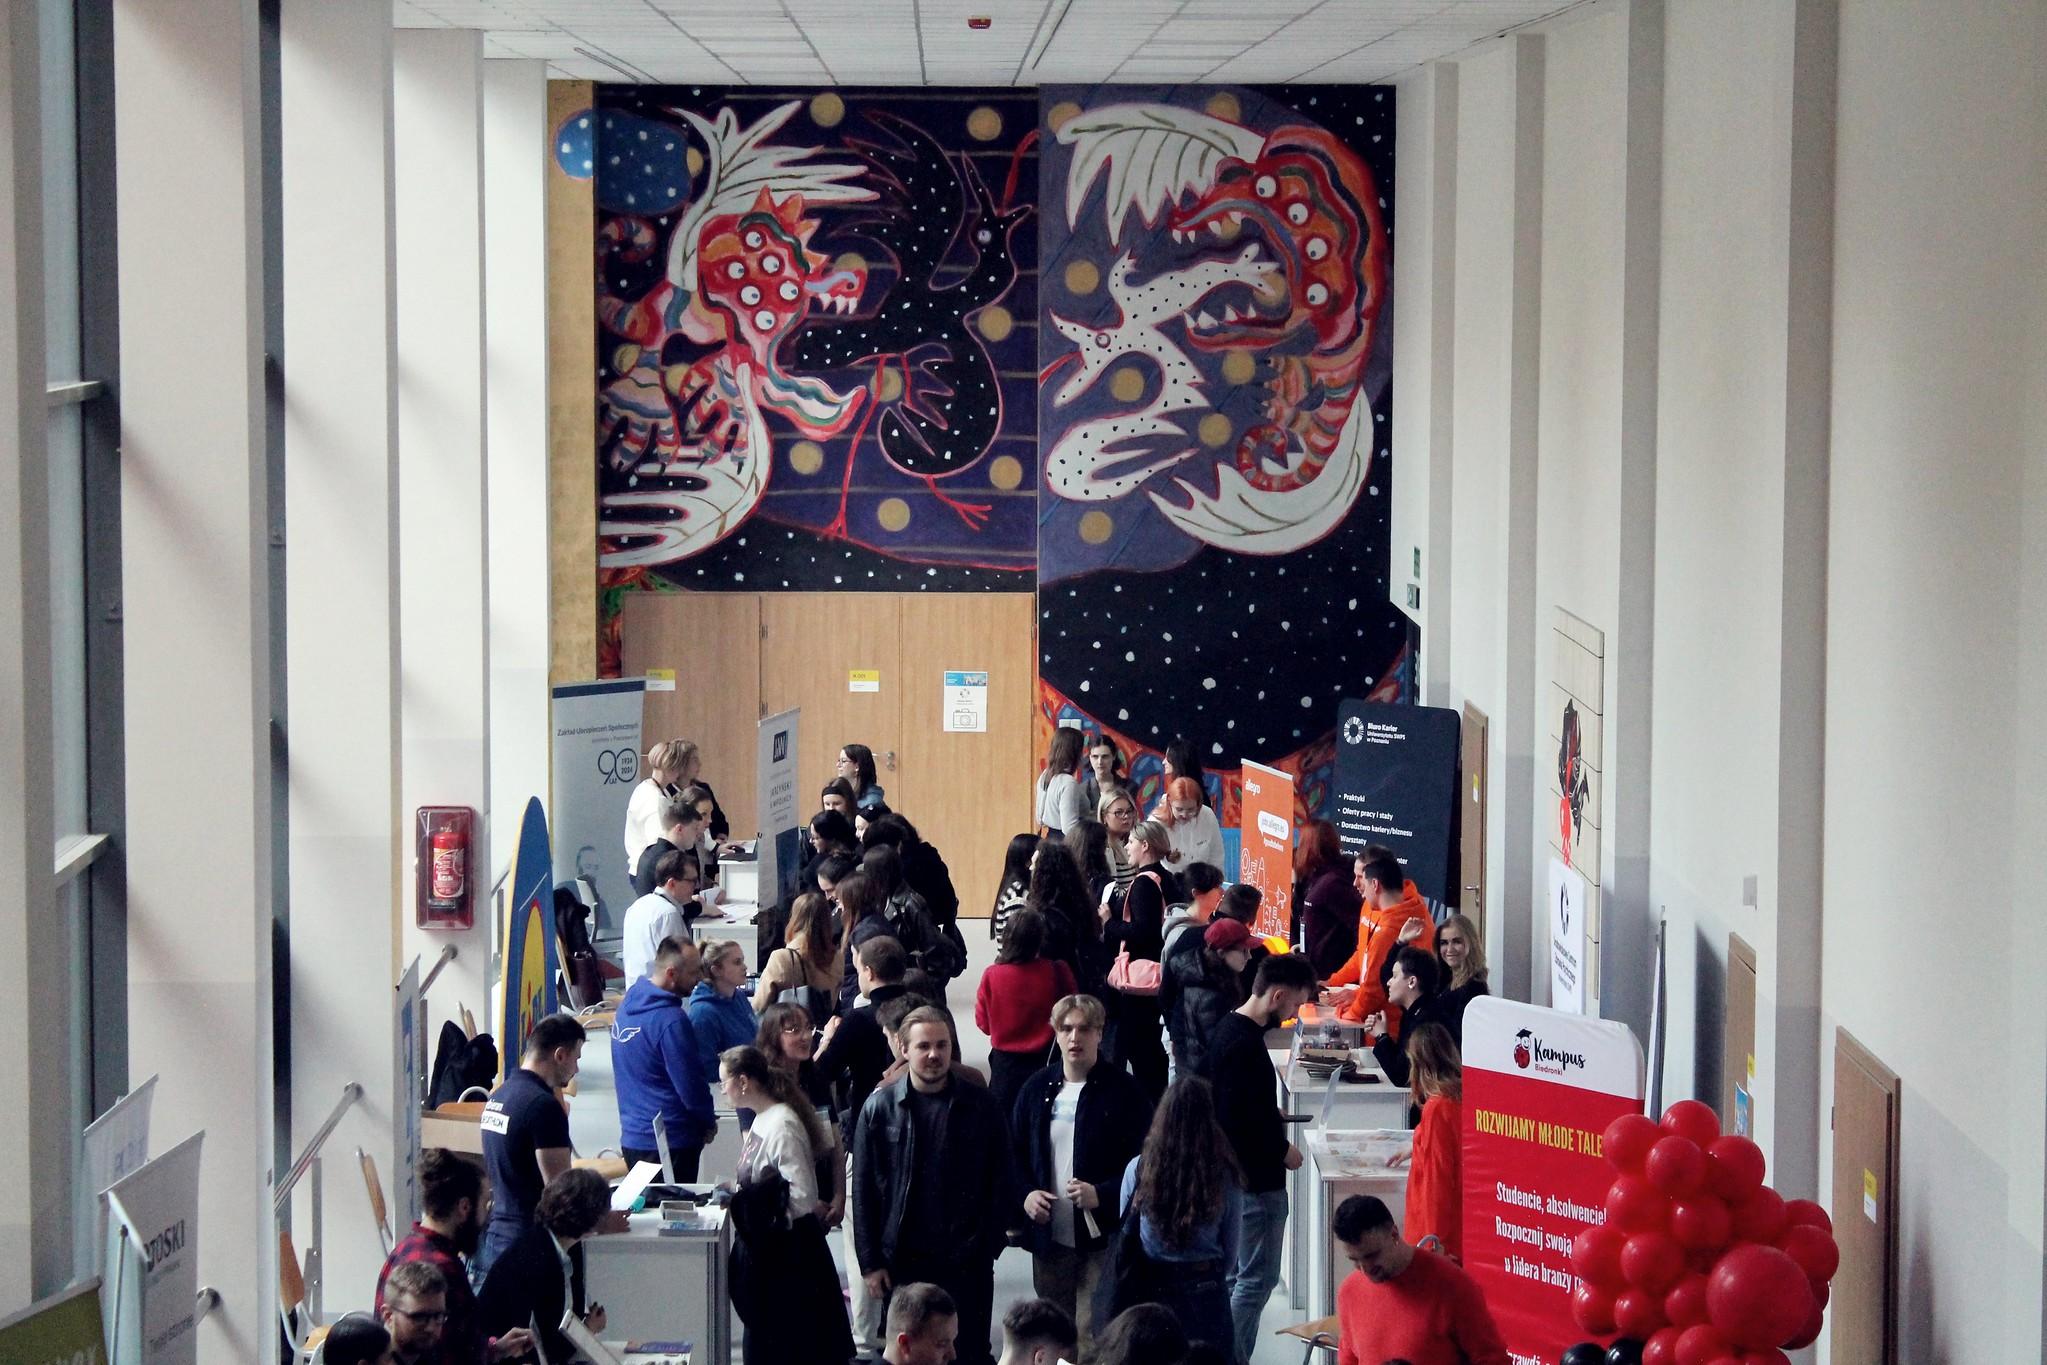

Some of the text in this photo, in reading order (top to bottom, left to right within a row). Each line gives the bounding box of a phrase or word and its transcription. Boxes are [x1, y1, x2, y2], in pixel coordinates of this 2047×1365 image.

[1367, 722, 1398, 732] Biuro Karier
[1343, 793, 1366, 803] Praktyki
[1342, 807, 1360, 817] Oferty
[1360, 810, 1376, 819] pracy
[1380, 812, 1393, 821] staży
[1341, 821, 1413, 837] Doradztwo kariery/biznesu
[1340, 834, 1367, 846] Warsztaty
[1534, 1037, 1586, 1071] Kampus
[1535, 1063, 1563, 1076] Biedronki
[1475, 1108, 1536, 1142] ROZWIJAMY
[1538, 1121, 1574, 1152] MŁODE
[1496, 1181, 1607, 1226] Studencie, absolwencie!
[1495, 1215, 1573, 1259] Rozpocznij swoją
[1512, 1254, 1540, 1281] lidera
[1541, 1262, 1572, 1294] branży
